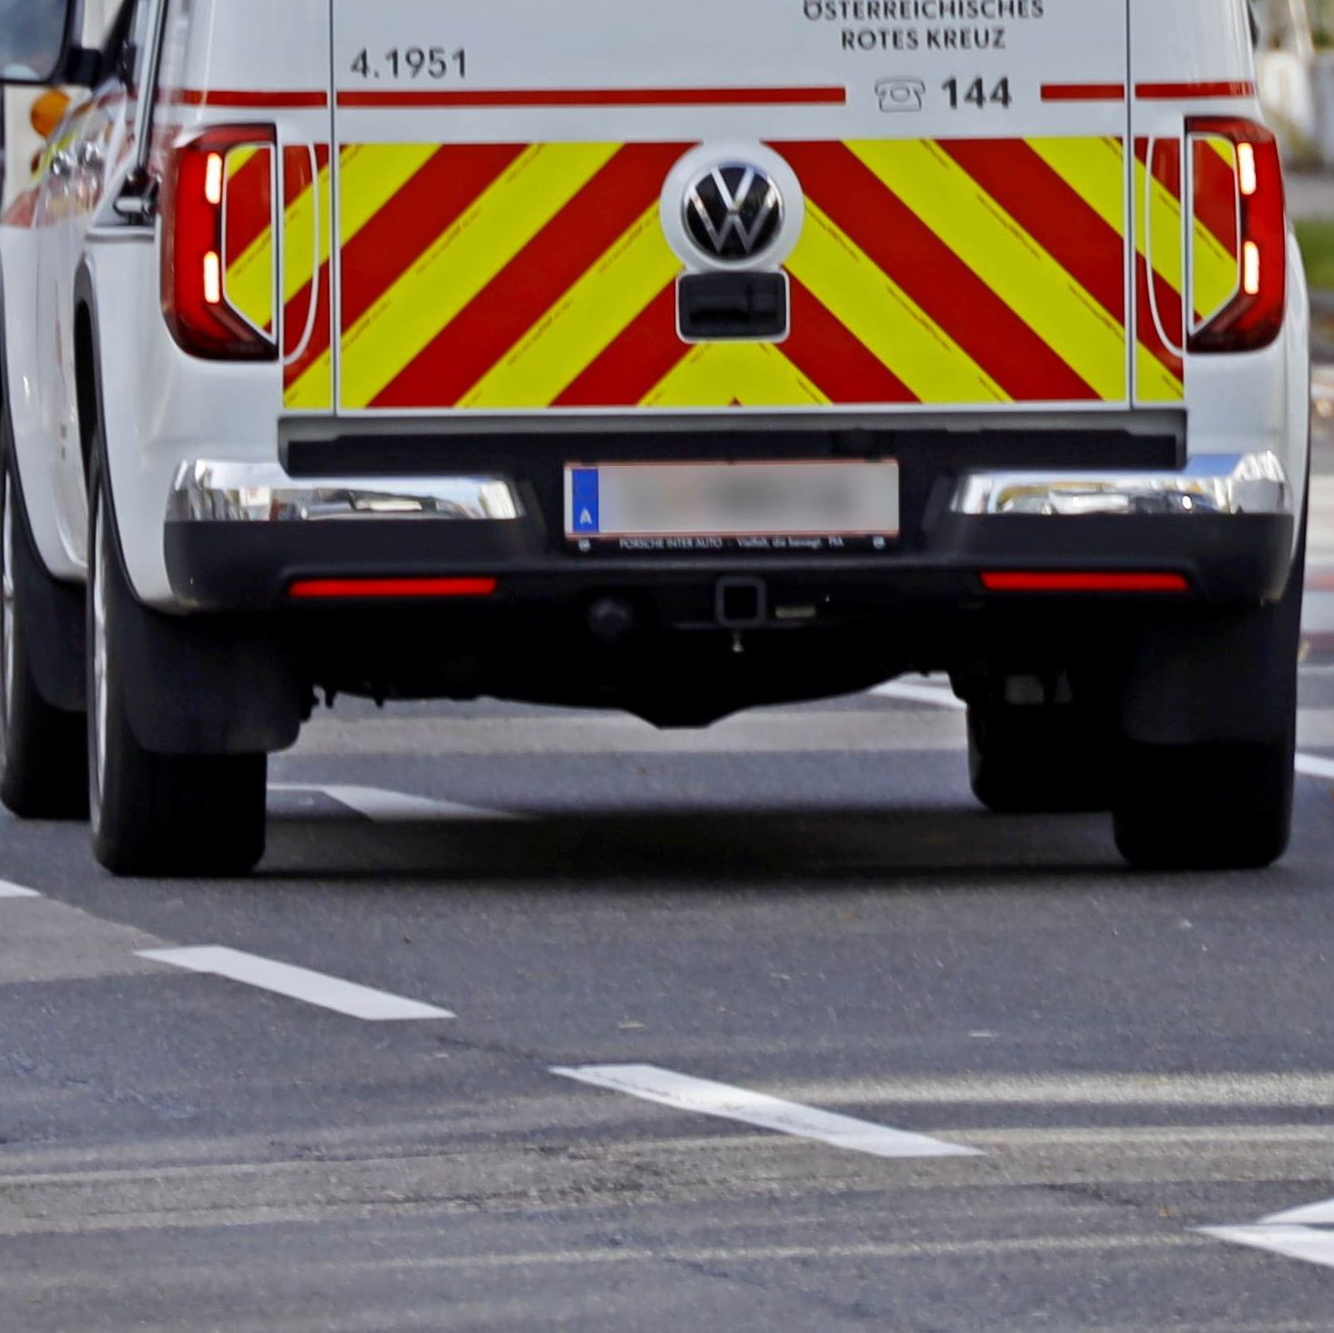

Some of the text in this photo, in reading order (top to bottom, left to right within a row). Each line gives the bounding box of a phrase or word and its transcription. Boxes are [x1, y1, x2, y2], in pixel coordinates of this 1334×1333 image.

[840, 27, 1006, 50] ROTES KREUZ
[350, 47, 466, 79] 4.1951
[940, 75, 1013, 110] 144
[579, 507, 593, 525] A
[619, 537, 664, 549] PORSCHE
[696, 536, 723, 548] AUTO
